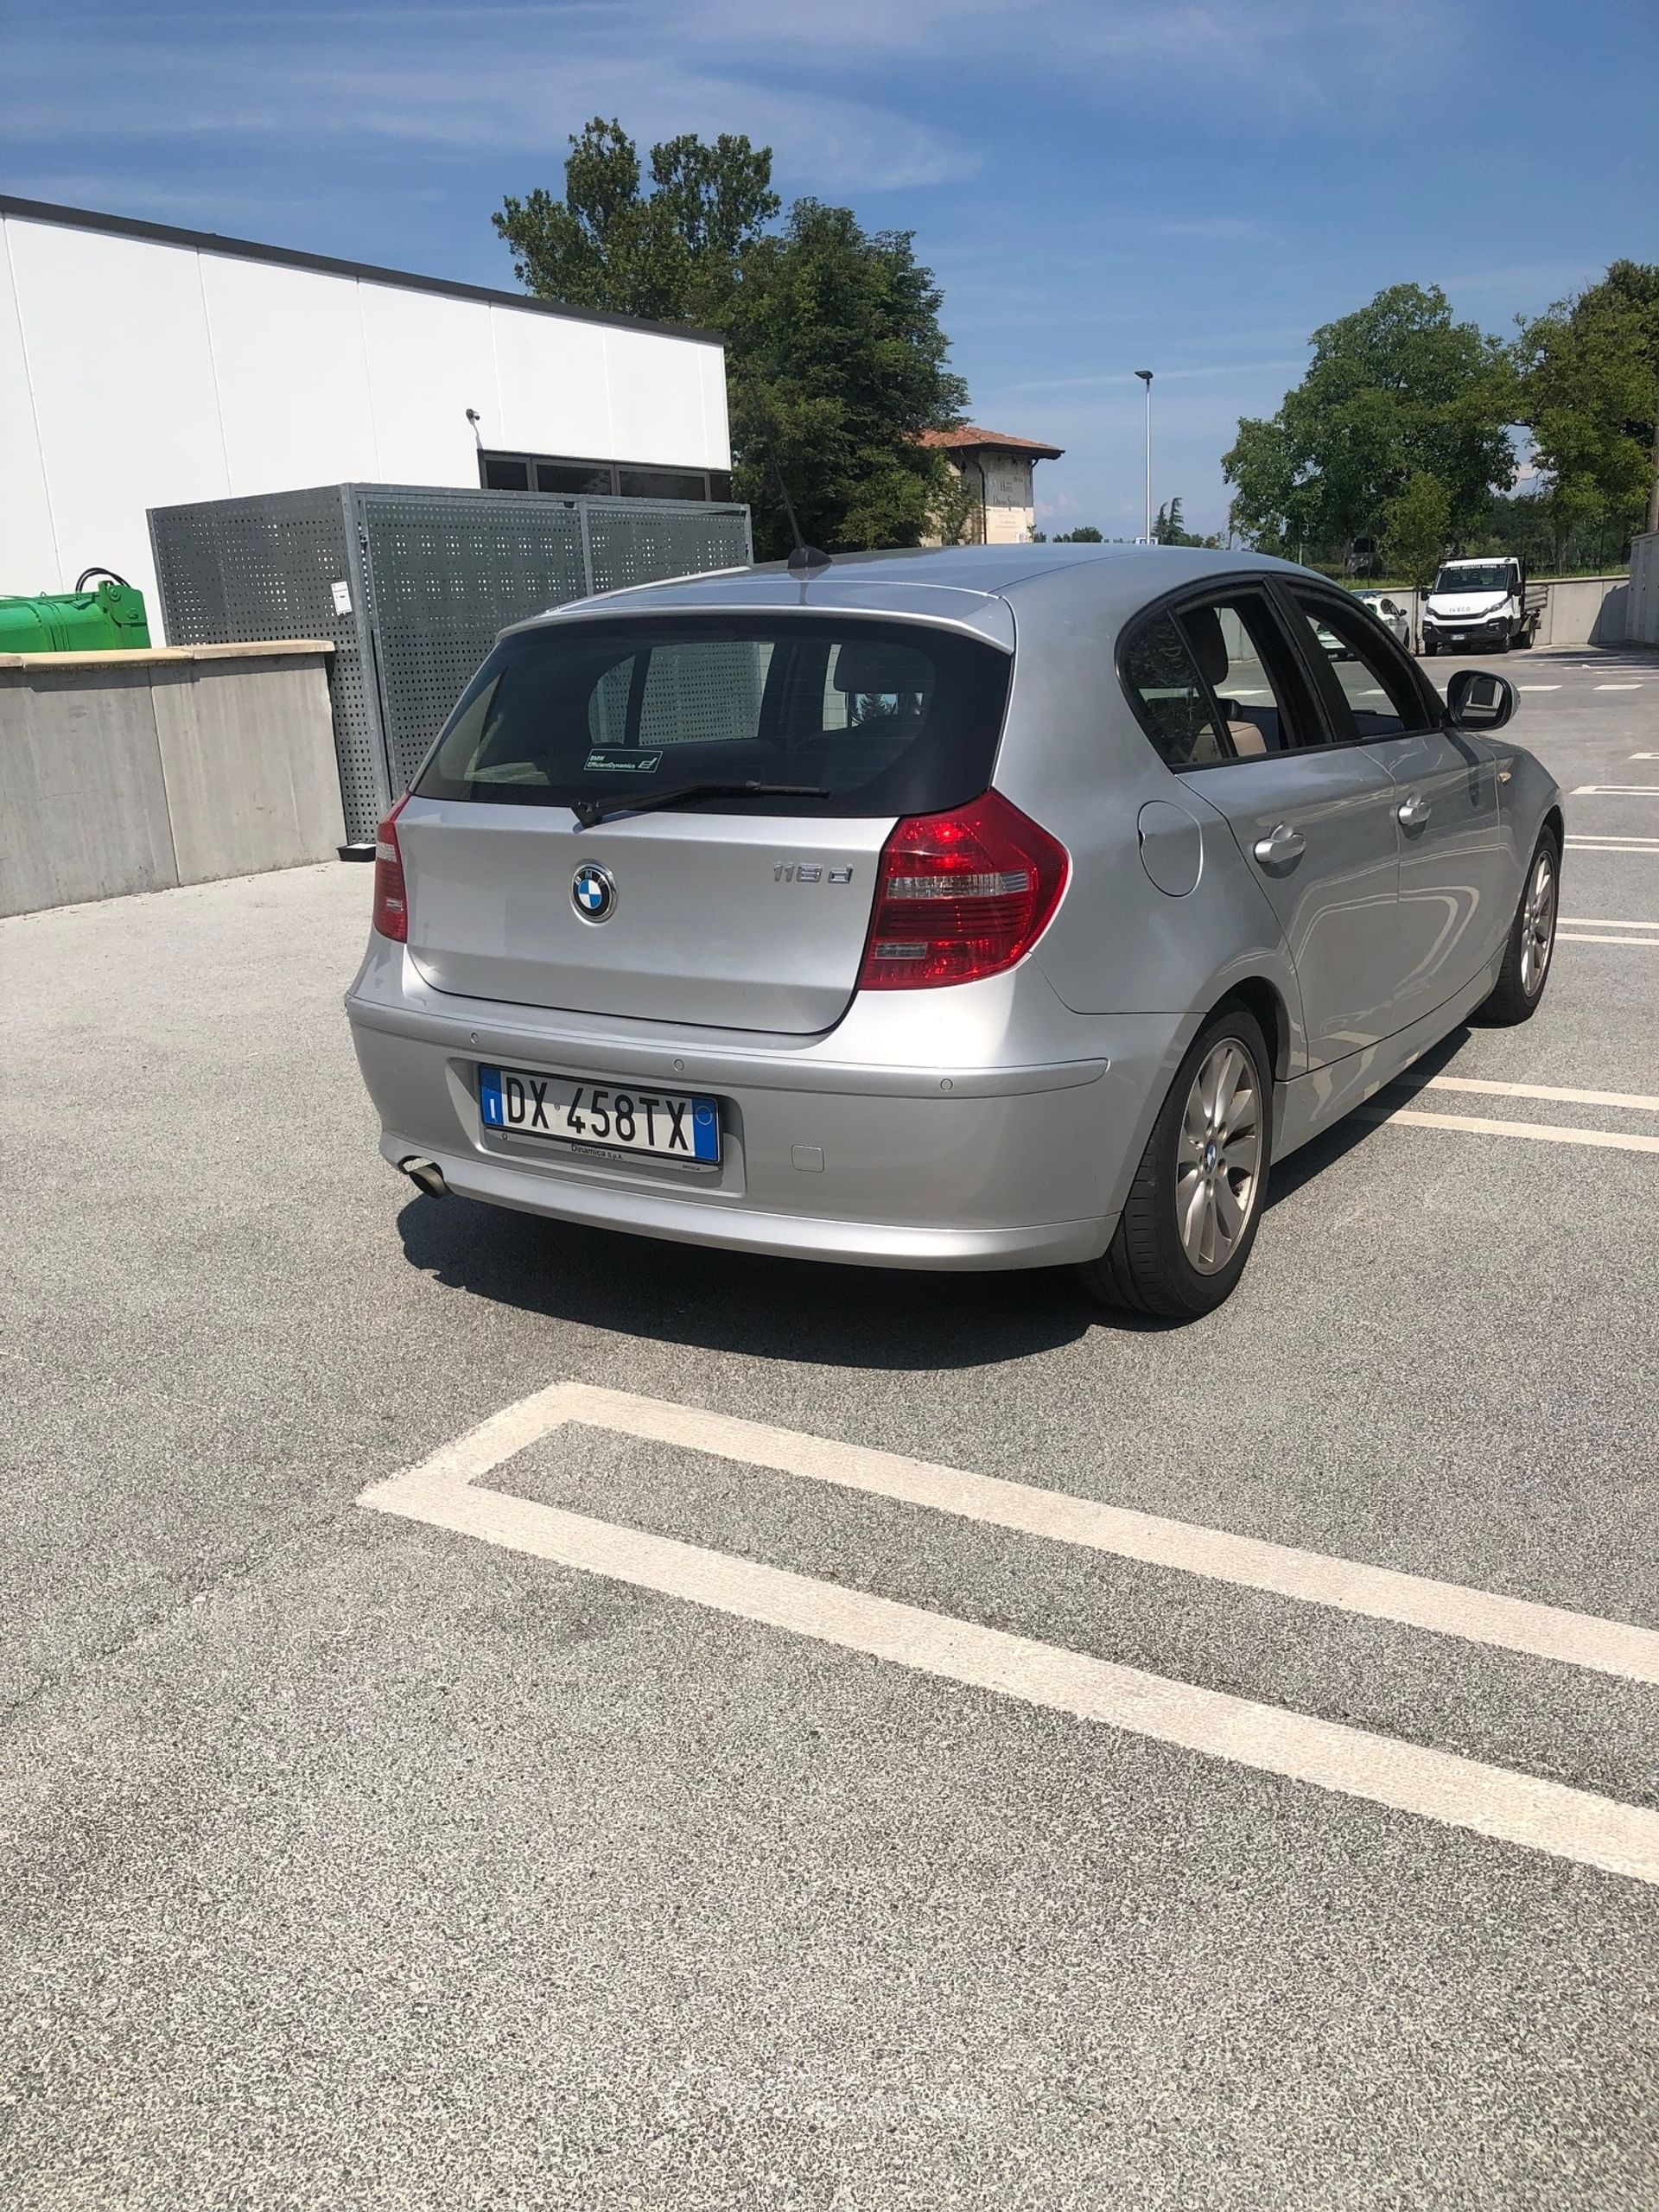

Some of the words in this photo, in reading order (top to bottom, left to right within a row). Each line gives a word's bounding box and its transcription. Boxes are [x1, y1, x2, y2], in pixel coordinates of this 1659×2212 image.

[505, 1076, 550, 1129] DX
[567, 1087, 689, 1151] 458TX
[571, 1144, 606, 1156] Dinamica
